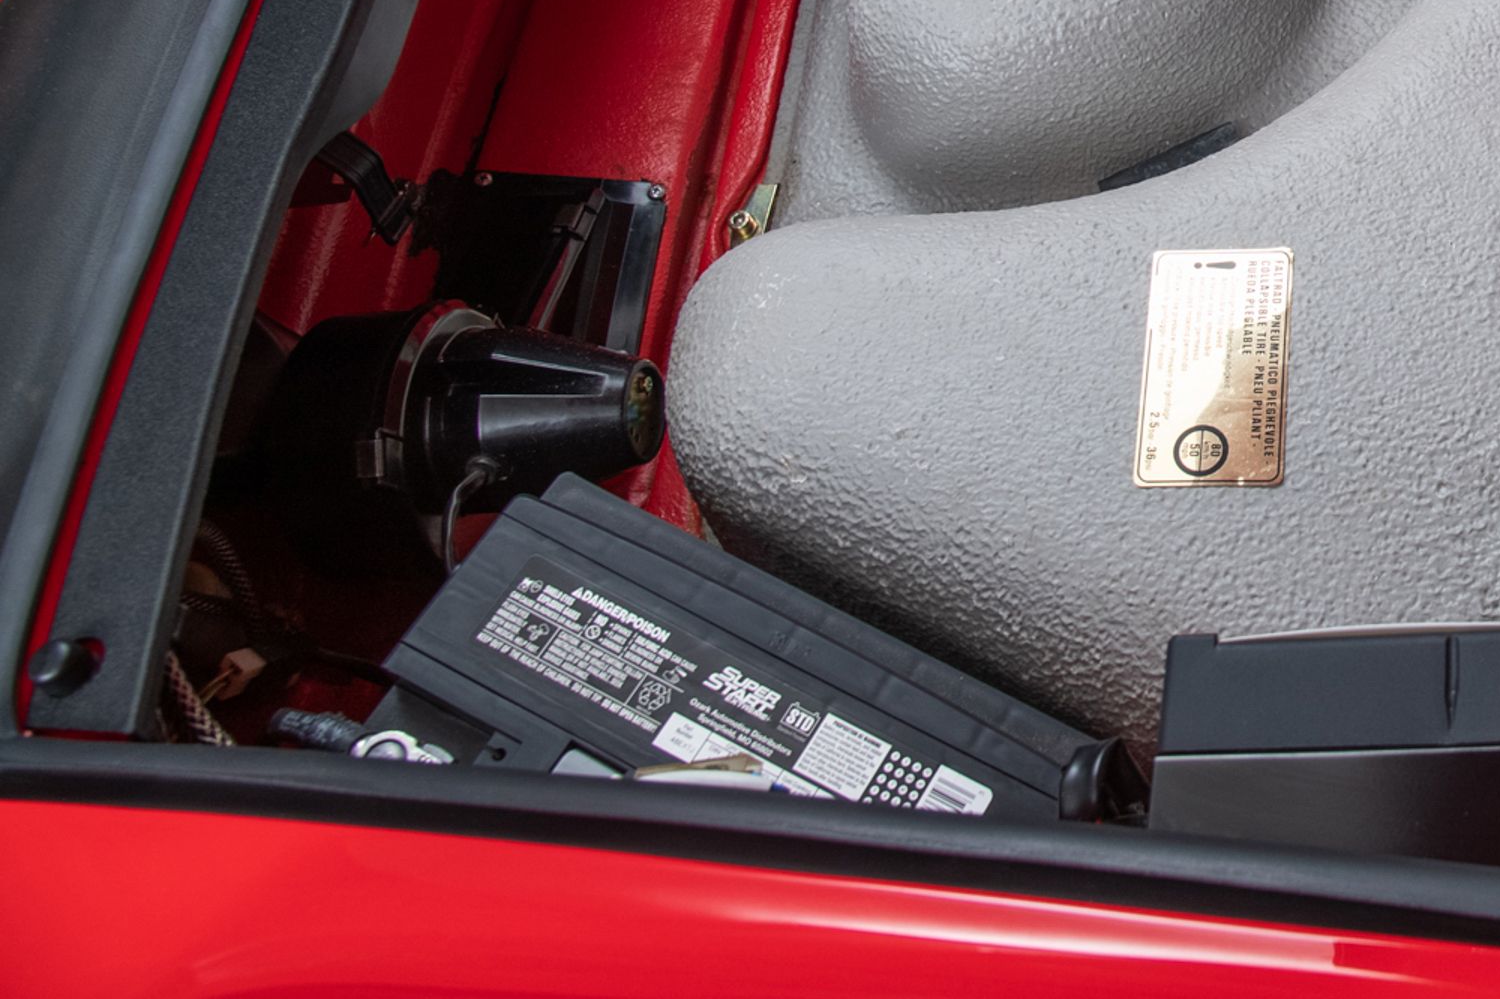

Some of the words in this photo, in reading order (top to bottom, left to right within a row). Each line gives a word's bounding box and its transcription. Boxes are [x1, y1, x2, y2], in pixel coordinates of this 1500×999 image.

[1246, 260, 1257, 294] RUEDA
[1257, 260, 1271, 327] COLLAPSIBLE
[1272, 260, 1284, 304] FALTRAD
[1255, 332, 1267, 356] TIRE
[1266, 313, 1280, 384] PNEUMATICO
[1252, 366, 1264, 394] PNEU
[1250, 399, 1263, 440] PLIANT
[1263, 390, 1277, 457] PIEGHEVOLE
[1188, 442, 1200, 457] 50
[1210, 442, 1221, 457] 80
[580, 587, 671, 644] DANGER/POISON
[701, 669, 776, 720] START
[720, 664, 783, 706] SUPER
[784, 706, 816, 734] STD
